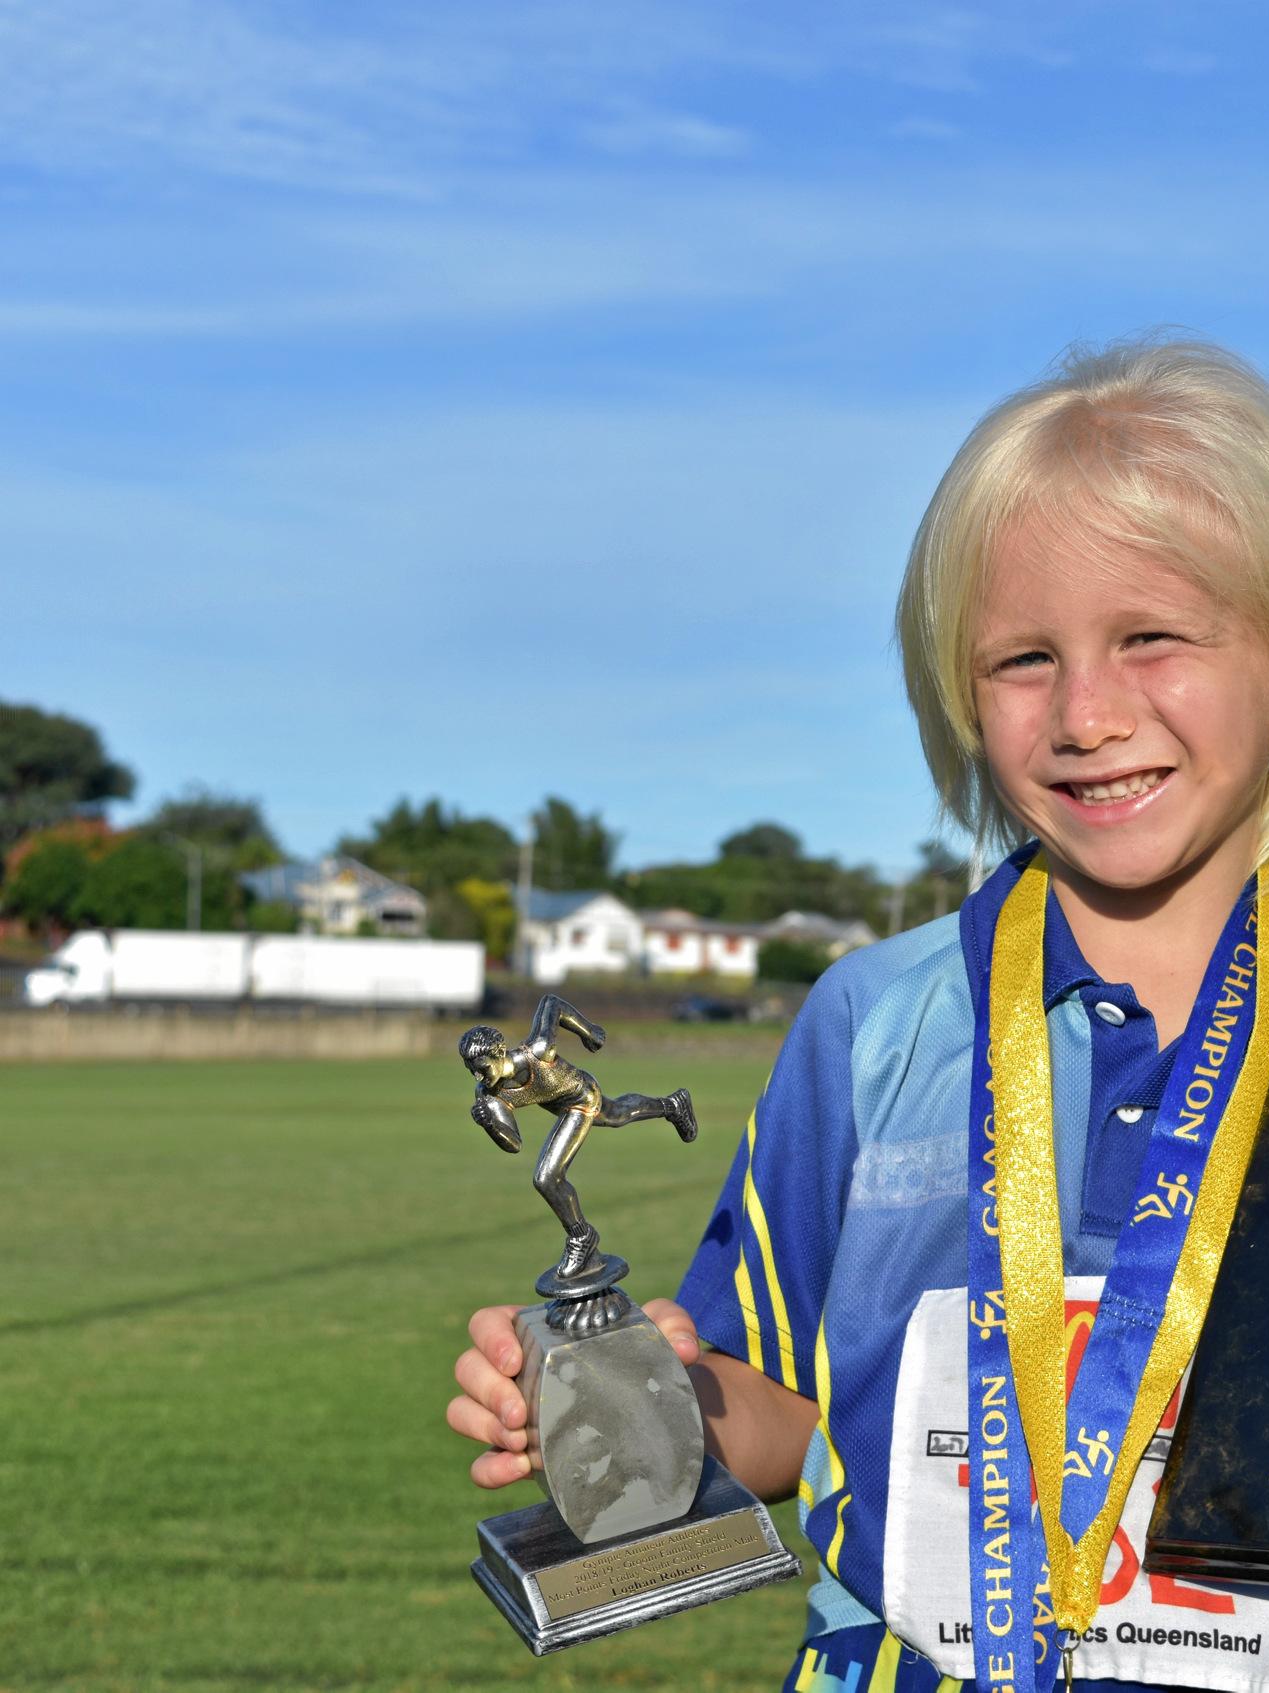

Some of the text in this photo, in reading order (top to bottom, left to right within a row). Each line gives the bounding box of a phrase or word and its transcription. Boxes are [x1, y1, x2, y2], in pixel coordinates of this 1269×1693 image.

[1173, 942, 1258, 1143] CHAMPION
[982, 1375, 1014, 1637] CHAMPION
[623, 1539, 665, 1557] Amateur
[623, 1556, 658, 1570] Groom
[659, 1543, 693, 1561] Family
[548, 1589, 574, 1604] Most
[576, 1580, 606, 1597] Points
[608, 1570, 640, 1588] Friday
[641, 1561, 671, 1578] Night
[671, 1542, 733, 1566] Competition
[611, 1562, 707, 1596] Loghan Roberts
[1117, 1622, 1262, 1656] Queensland
